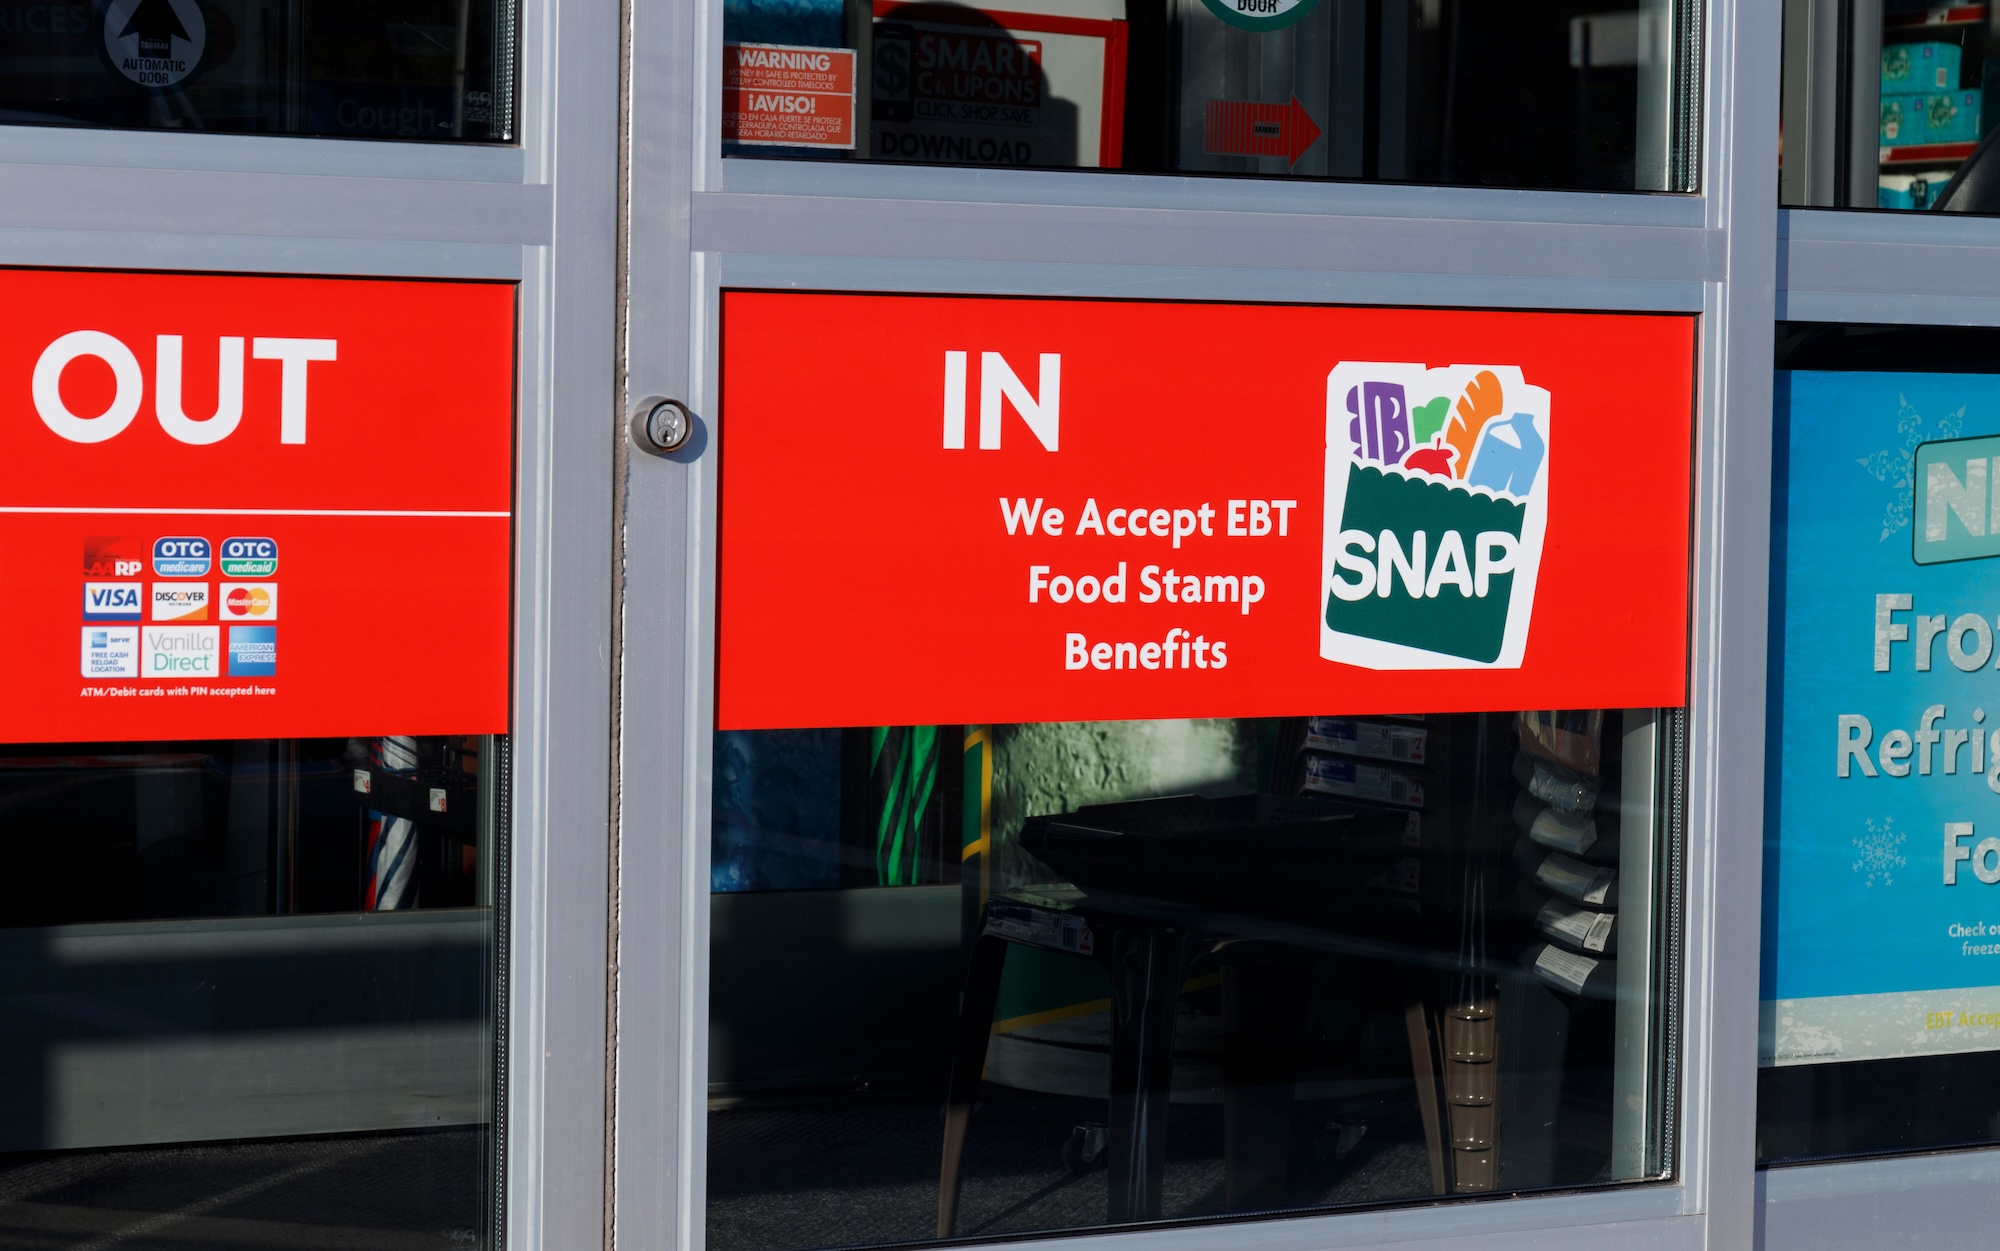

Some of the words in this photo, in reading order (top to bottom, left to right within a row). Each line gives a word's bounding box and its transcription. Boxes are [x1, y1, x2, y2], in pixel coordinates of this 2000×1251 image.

[1238, 0, 1277, 13] DOOR
[140, 41, 169, 51] TORMAX
[737, 50, 830, 71] WARNING
[917, 34, 1038, 77] SMART
[123, 58, 186, 72] AUTOMATIC
[139, 72, 169, 84] DOOR
[728, 68, 754, 77] MONEY
[765, 70, 781, 79] SAFE
[783, 72, 789, 80] IS
[790, 72, 827, 81] PROTECTED
[731, 77, 750, 85] DELAY
[753, 78, 796, 88] CONTROLLED
[798, 80, 834, 90] TIMELOCKS
[748, 94, 816, 114] ¡AVISO!
[336, 98, 436, 136] Cough
[749, 113, 758, 121] EN
[760, 114, 777, 122] CAJA
[780, 114, 802, 123] FUERTE
[813, 116, 842, 125] PROTEGE
[755, 130, 786, 138] HORARIO
[788, 132, 827, 140] RETARDADO
[779, 122, 824, 132] CONTROLADA
[826, 125, 841, 133] QUE
[881, 131, 1031, 163] DOWNLOAD
[32, 330, 337, 445] OUT
[943, 350, 1061, 452] IN
[999, 497, 1064, 536] We
[1075, 497, 1215, 549] Accept
[1227, 499, 1297, 537] EBT
[161, 541, 204, 557] OTC
[228, 541, 271, 557] OTC
[160, 561, 205, 573] medicare
[227, 561, 273, 573] medicaid
[1330, 528, 1520, 601] SNAP
[1029, 561, 1127, 604] Food
[1139, 564, 1265, 615] Stamp
[88, 588, 138, 607] VISA
[155, 592, 204, 601] DISCOVER
[227, 598, 269, 607] MasterCard
[1874, 593, 2000, 673] Fro
[149, 633, 214, 651] Vanilla
[230, 644, 273, 652] AMERICAN
[1065, 627, 1228, 670] Benefits
[154, 653, 210, 671] Direct
[239, 653, 276, 661] EXPRESS
[80, 687, 137, 697] ATM/Debit
[139, 686, 164, 696] cards
[166, 686, 188, 696] with
[190, 686, 208, 695] PIN
[209, 686, 252, 698] accepted
[254, 686, 276, 696] here
[1948, 921, 1986, 938] Check
[1989, 924, 2000, 936] o
[1926, 1012, 1954, 1030] EBT
